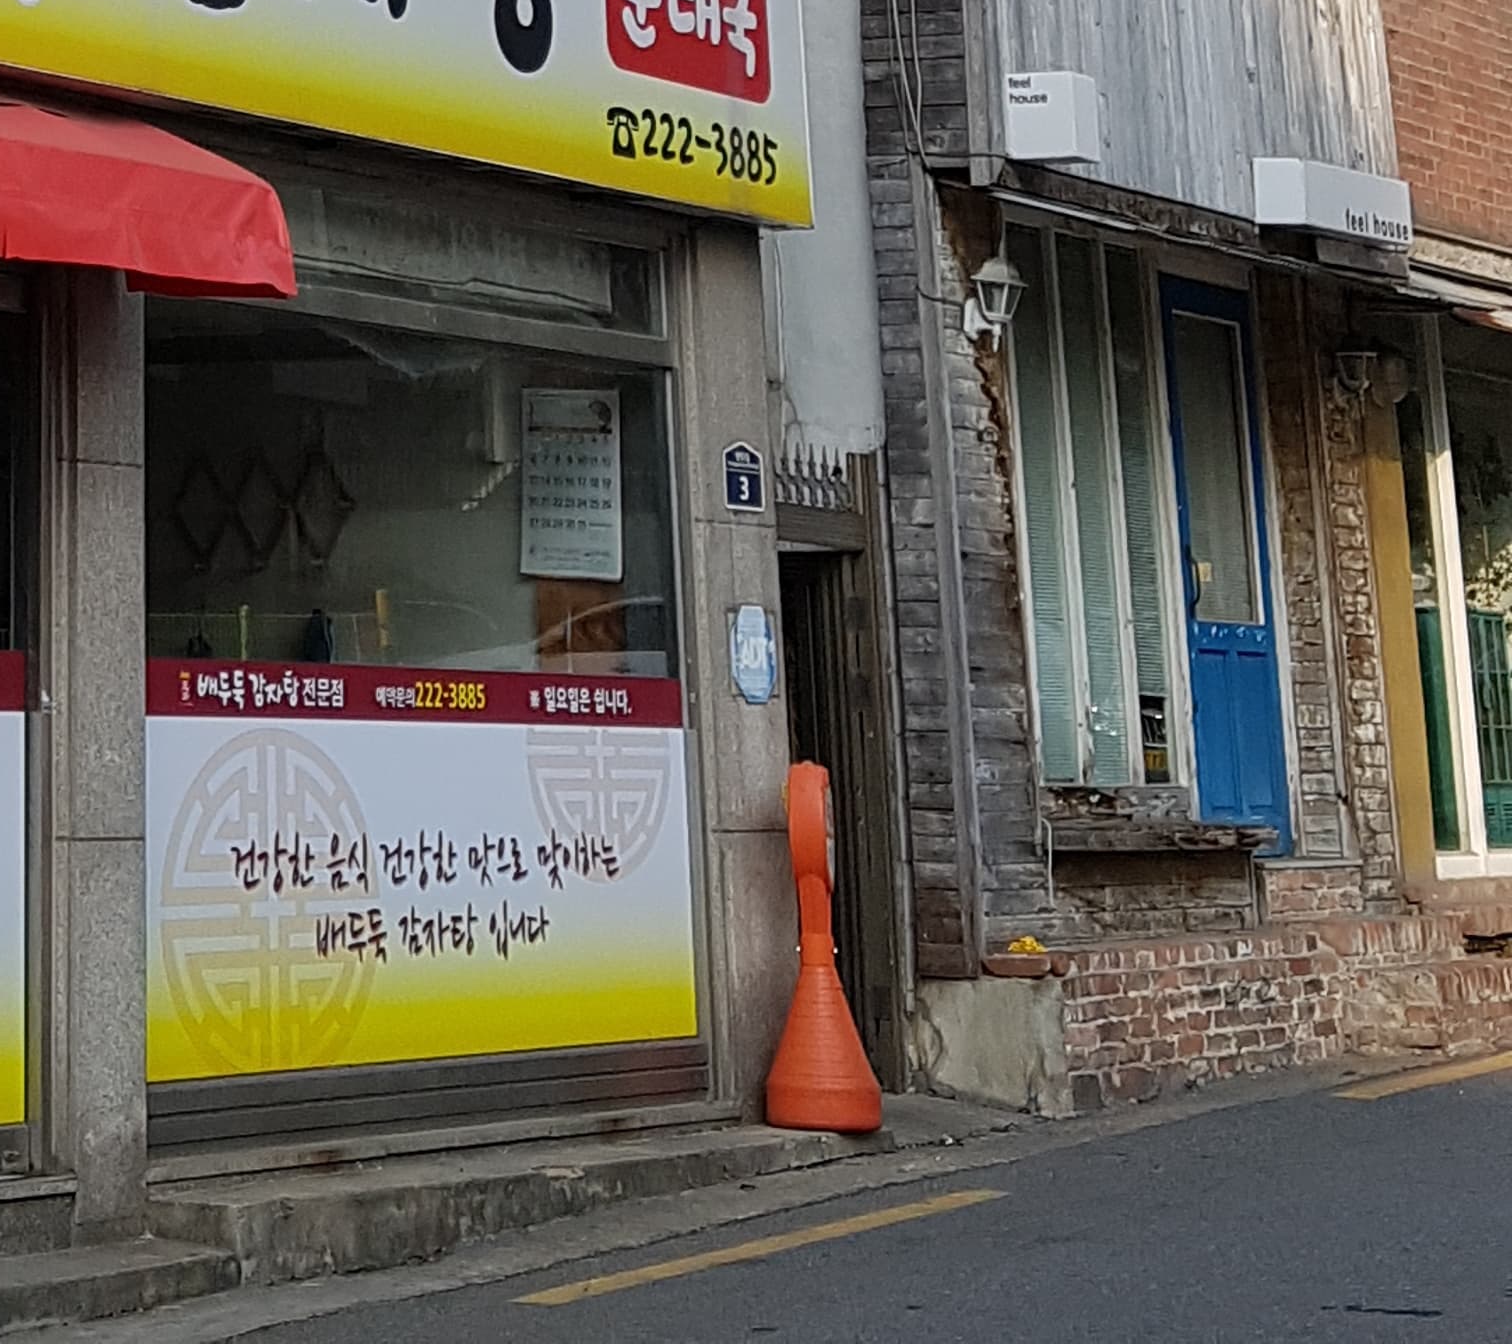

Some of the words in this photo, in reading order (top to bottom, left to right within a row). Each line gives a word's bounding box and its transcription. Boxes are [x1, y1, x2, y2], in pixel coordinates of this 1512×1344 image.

[1009, 93, 1048, 105] house
[642, 109, 779, 187] 222-3885
[1345, 207, 1368, 232] feel
[1373, 211, 1409, 241] house
[739, 476, 750, 501] 3
[197, 669, 245, 710] 배두둑
[249, 670, 299, 707] 감자탕
[302, 677, 345, 708] 전문점
[229, 830, 316, 893] 건강한
[326, 832, 369, 894] 음식
[378, 829, 458, 891] 건강한
[468, 831, 529, 888] 맛으로
[536, 828, 622, 890] 맞이하는
[314, 907, 389, 965] 배두둑
[397, 902, 479, 958] 감자탕
[489, 898, 552, 962] 입니다
